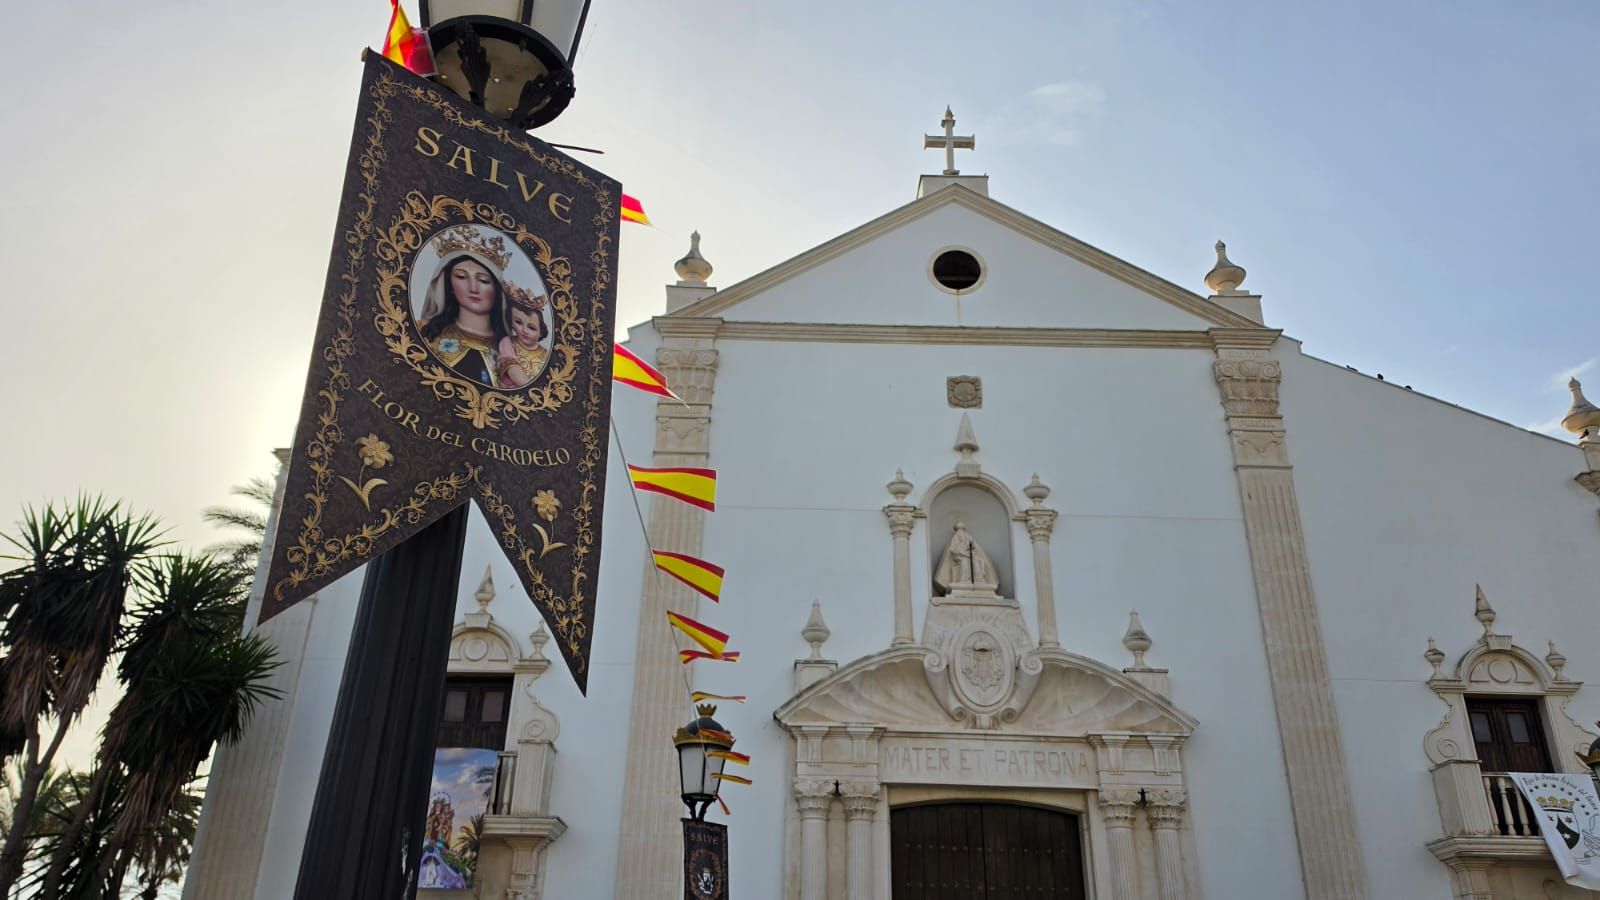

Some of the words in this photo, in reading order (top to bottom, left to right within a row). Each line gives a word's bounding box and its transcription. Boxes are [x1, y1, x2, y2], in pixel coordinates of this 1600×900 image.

[414, 126, 575, 225] SALVE
[356, 376, 424, 436] FLOR
[426, 426, 464, 448] DEL
[471, 437, 571, 467] CARMELO
[884, 746, 949, 770] MATER
[959, 748, 985, 773] ET
[995, 750, 1090, 776] PATRONA
[689, 832, 719, 845] SALVE
